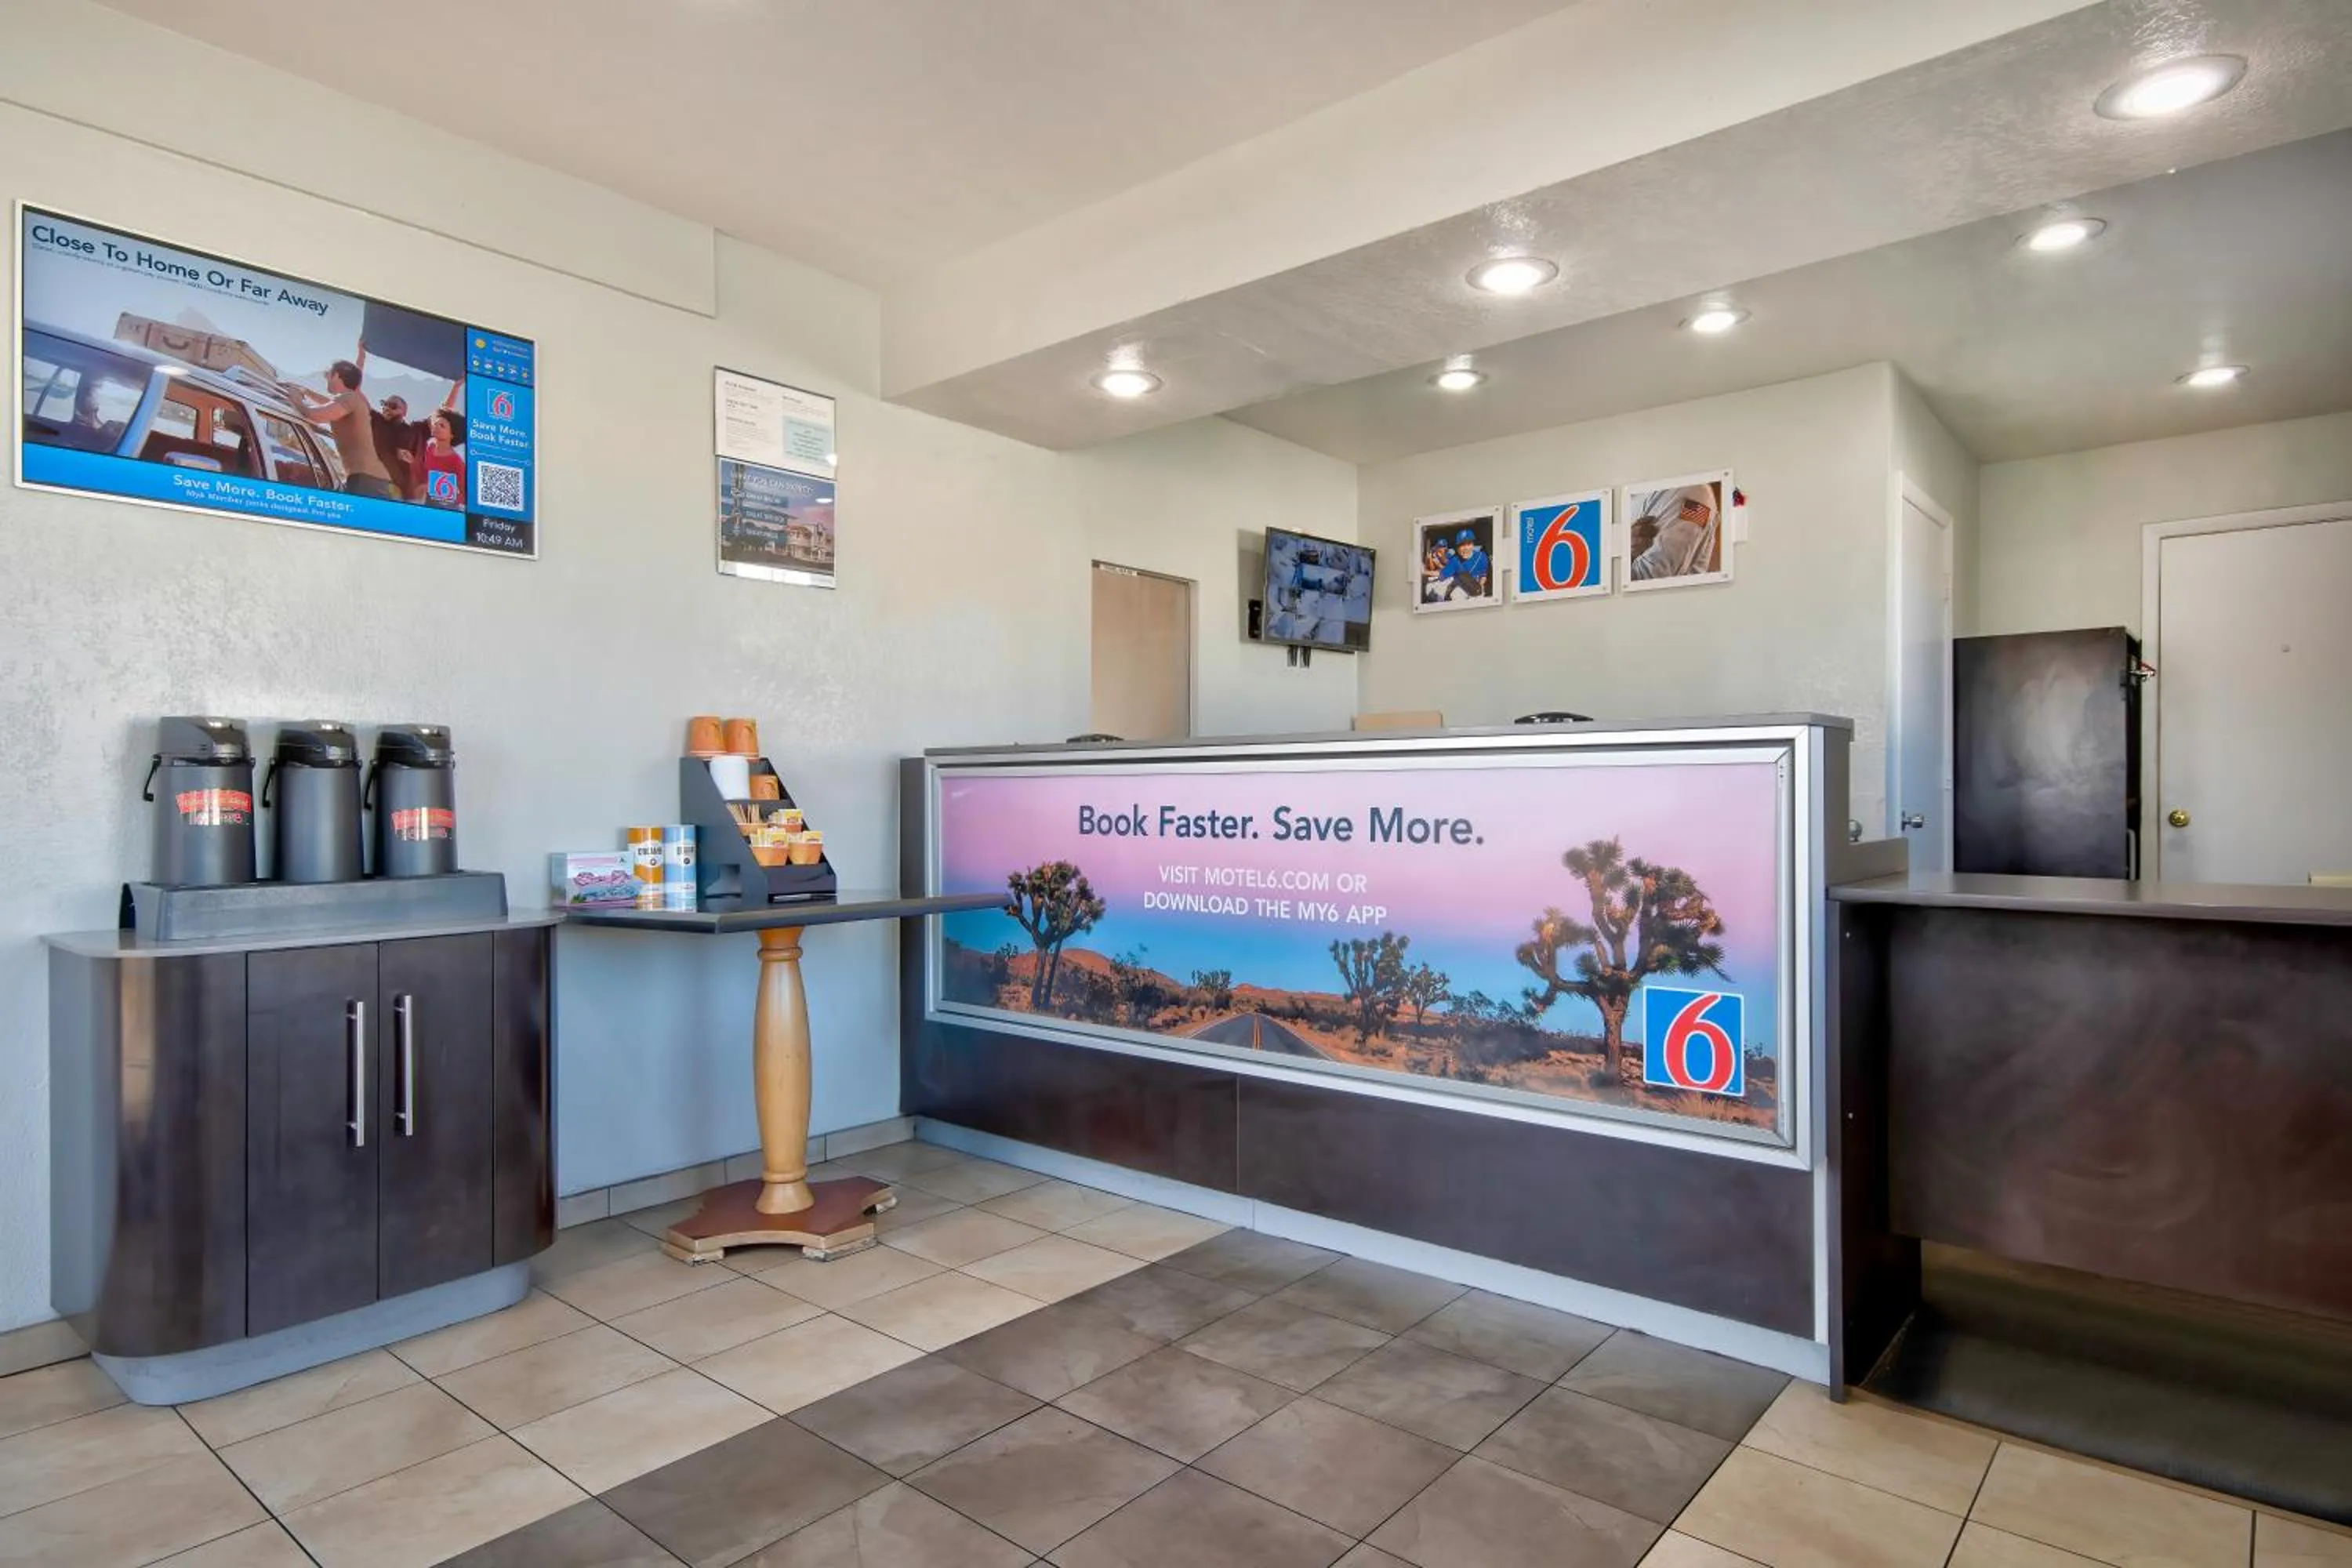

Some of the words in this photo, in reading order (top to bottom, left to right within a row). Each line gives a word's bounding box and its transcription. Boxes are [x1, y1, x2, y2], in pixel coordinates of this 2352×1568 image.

[32, 224, 95, 254] Close
[102, 241, 129, 263] To
[136, 251, 200, 281] Home
[207, 270, 234, 289] Or
[241, 278, 271, 299] Far
[277, 289, 329, 316] Away
[470, 429, 496, 442] Book
[173, 474, 211, 490] Save
[216, 481, 261, 499] More.
[266, 488, 303, 505] Book
[308, 495, 355, 512] Faster.
[476, 532, 503, 545] 10:49
[504, 536, 524, 549] AM
[482, 517, 516, 533] Friday
[1534, 504, 1591, 590] 6
[1079, 804, 1149, 837] Book
[1160, 805, 1258, 839] Faster.
[1272, 806, 1353, 841] Save
[1370, 807, 1484, 845] More.
[1159, 865, 1200, 884] VISIT
[1205, 868, 1329, 891] MOTEL6.COM
[1337, 873, 1368, 894] OR
[1143, 891, 1249, 915] DOWNLOAD
[1254, 898, 1290, 919] THE
[1298, 901, 1339, 923] MY6
[1346, 905, 1388, 925] APP
[1663, 993, 1736, 1092] 6
